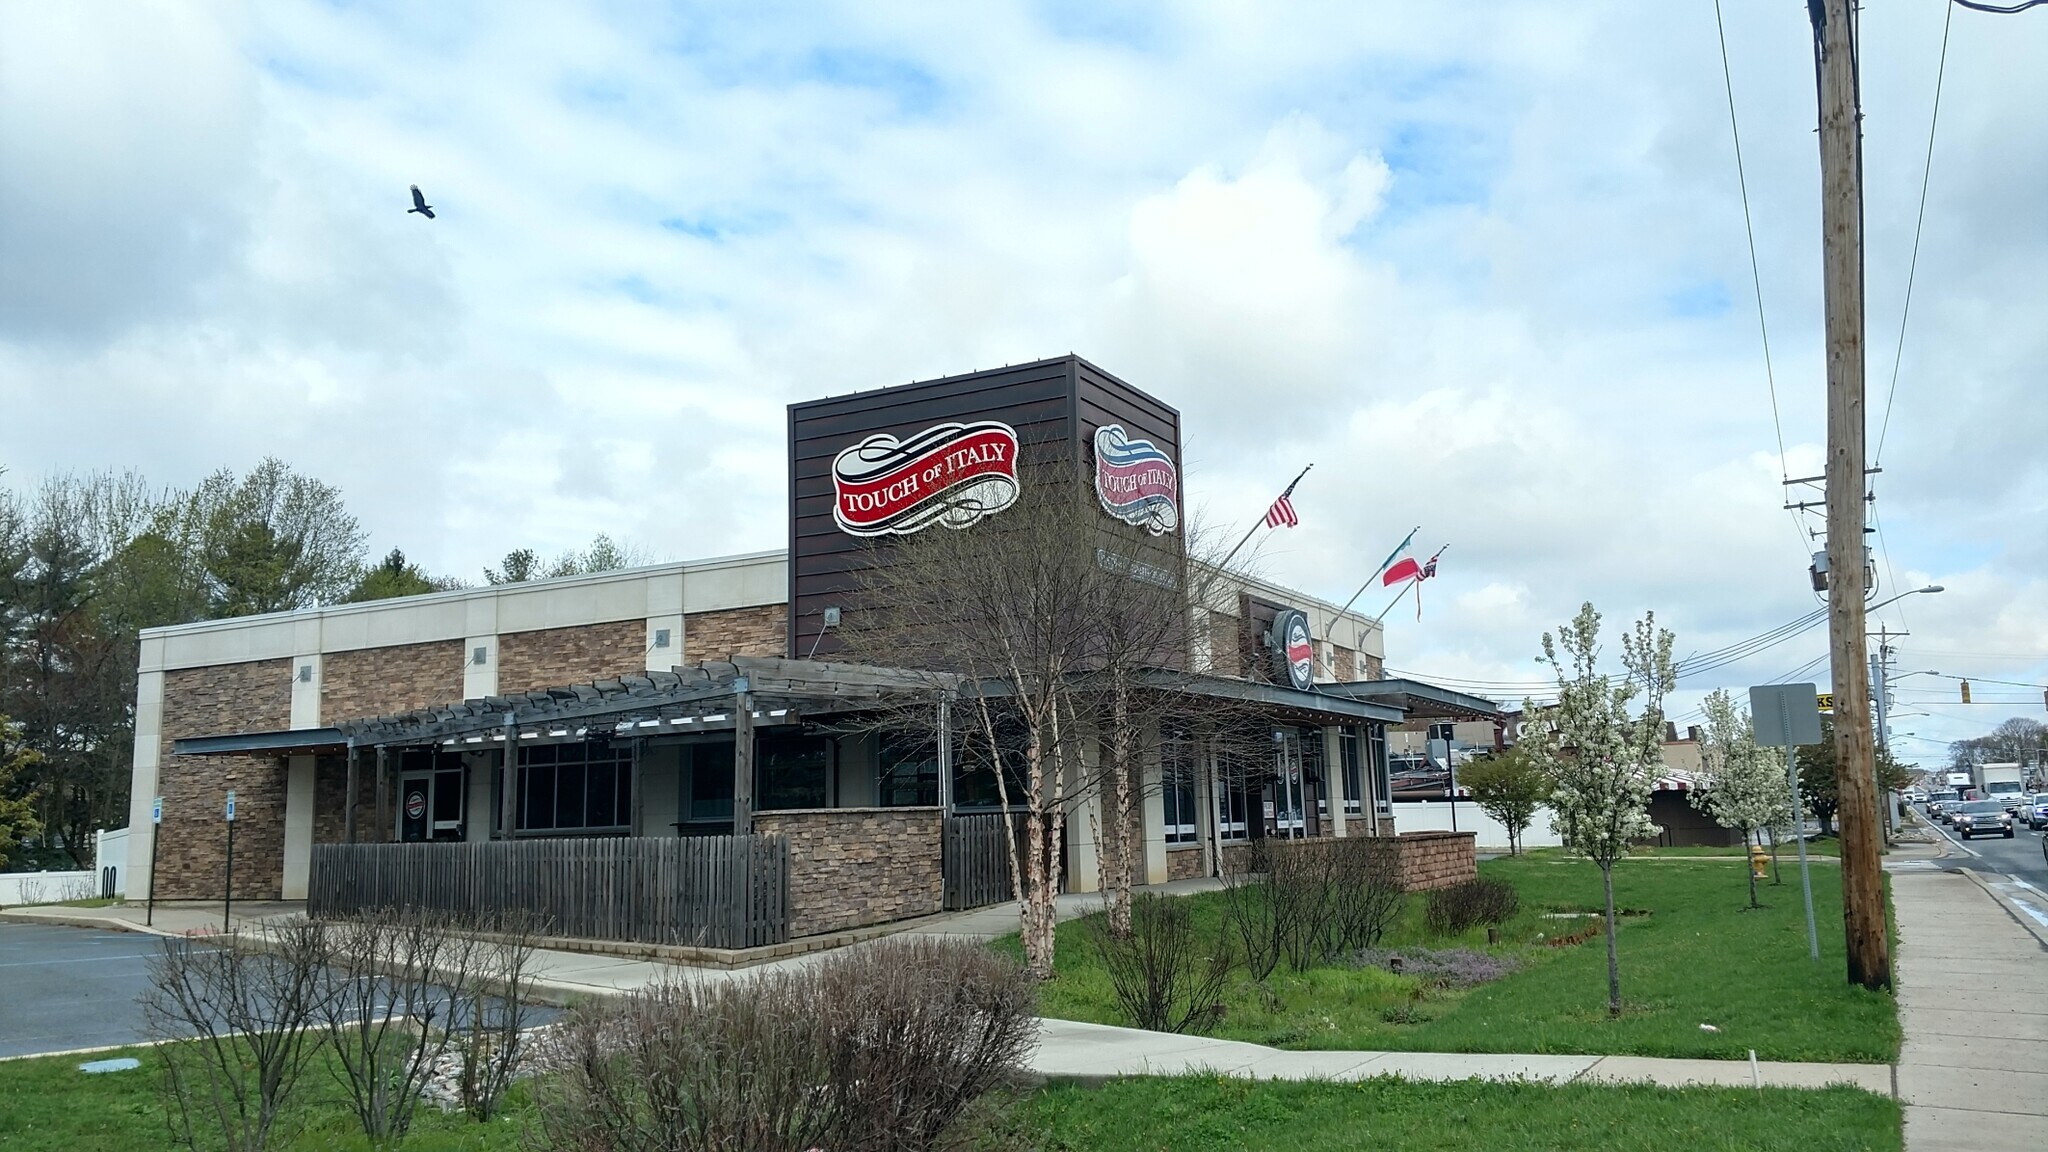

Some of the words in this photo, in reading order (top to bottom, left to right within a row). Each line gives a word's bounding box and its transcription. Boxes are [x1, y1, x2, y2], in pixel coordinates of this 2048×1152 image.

[843, 473, 920, 512] TOUCH
[922, 464, 943, 483] OF
[945, 443, 1007, 475] ITALY
[1102, 469, 1138, 493] TOUCH
[1137, 474, 1147, 486] OF
[1147, 468, 1173, 491] ITALY
